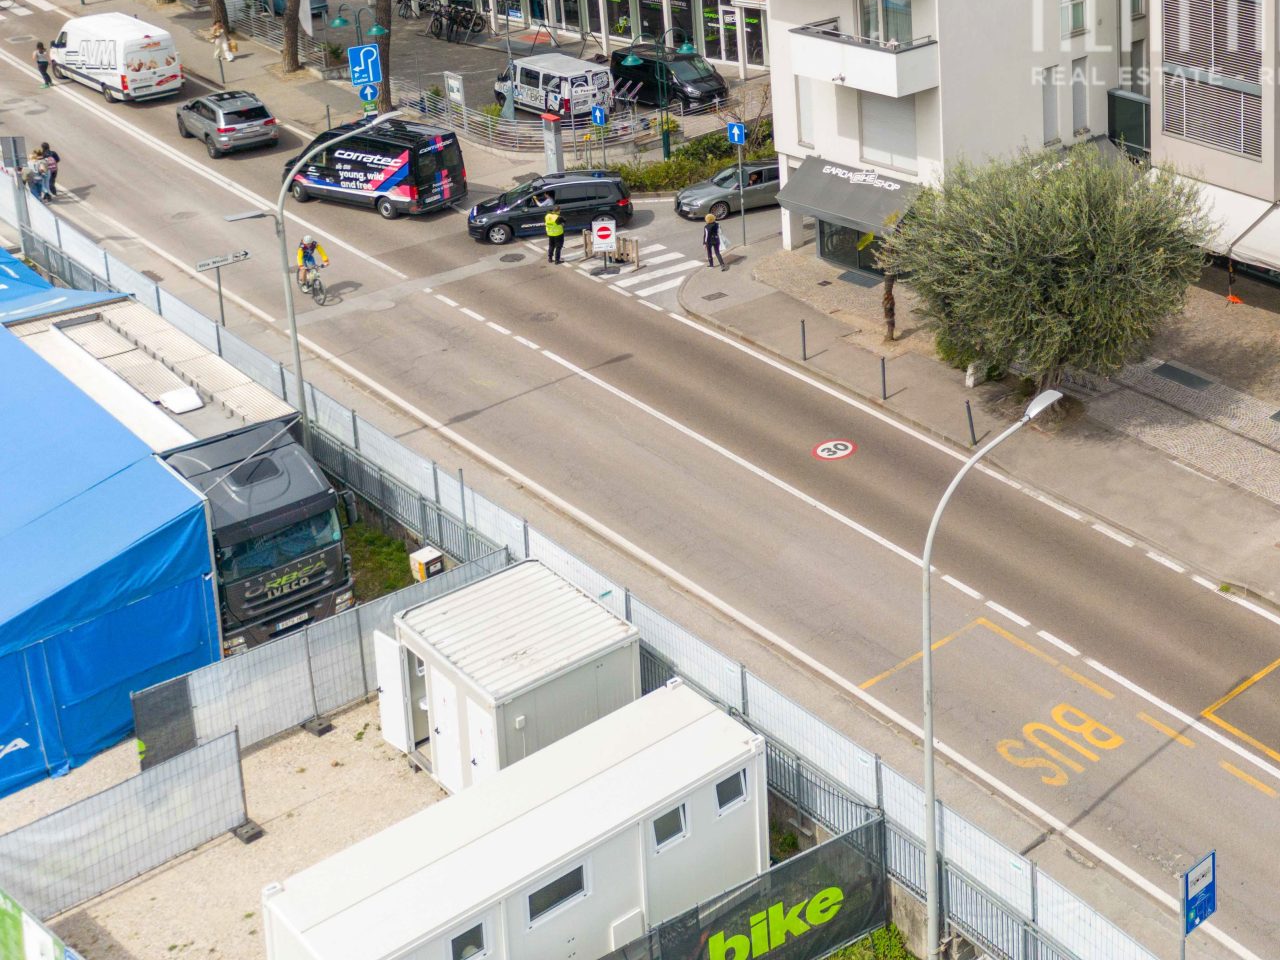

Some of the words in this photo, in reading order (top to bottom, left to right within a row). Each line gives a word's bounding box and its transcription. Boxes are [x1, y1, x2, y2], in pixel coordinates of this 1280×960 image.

[334, 149, 402, 167] corratec
[339, 170, 366, 180] young,
[367, 171, 385, 180] wild
[340, 180, 356, 189] and
[357, 181, 375, 190] free.
[822, 165, 853, 180] GARDA
[852, 172, 877, 184] BIKE
[873, 179, 901, 191] SHOP
[820, 442, 849, 456] 30
[245, 553, 325, 588] STRALIS
[267, 577, 310, 599] IVECO
[996, 702, 1125, 787] BUS
[708, 886, 844, 960] bike
